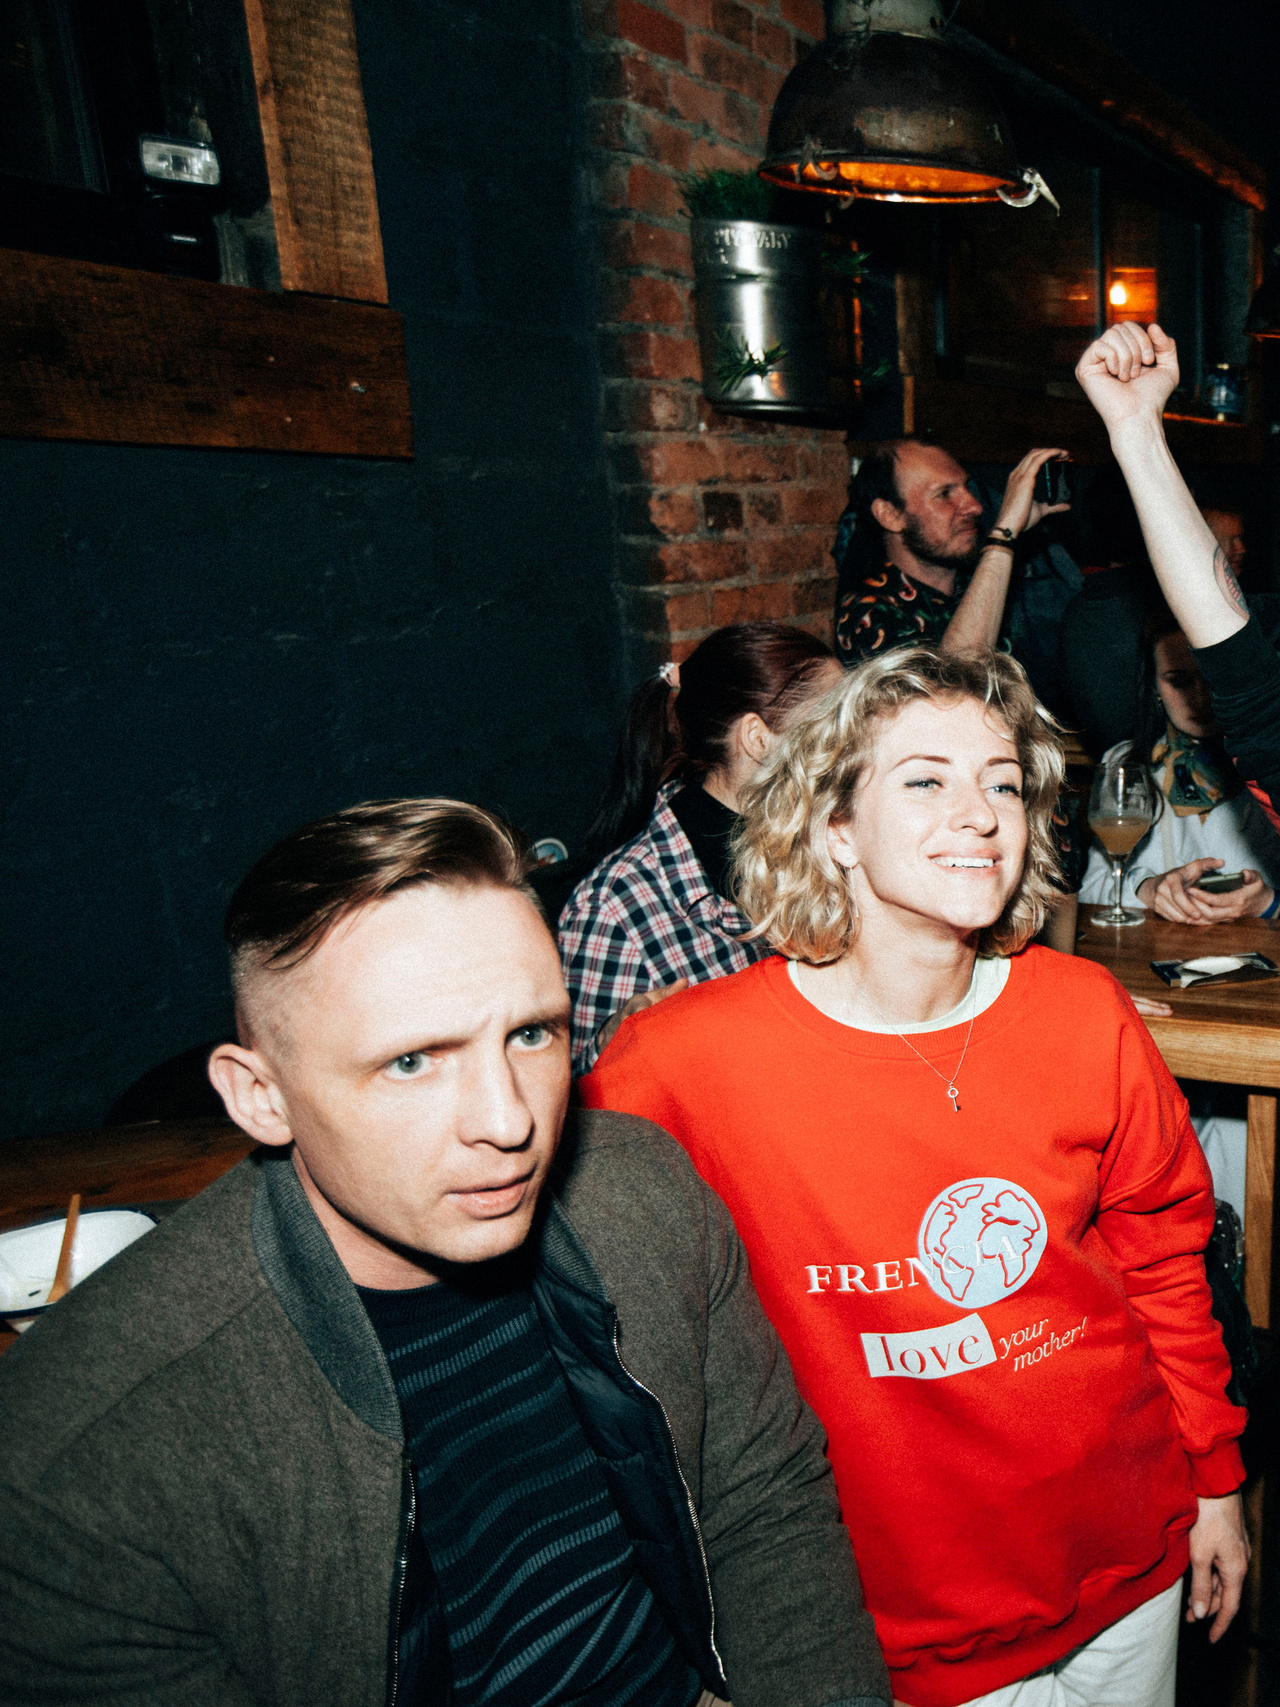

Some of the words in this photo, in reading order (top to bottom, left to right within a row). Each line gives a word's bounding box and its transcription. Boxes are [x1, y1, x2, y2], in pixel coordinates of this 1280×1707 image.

[804, 1234, 1023, 1294] FRENCIA
[877, 1334, 984, 1375] love
[998, 1317, 1049, 1360] your
[1013, 1315, 1088, 1372] mother!
